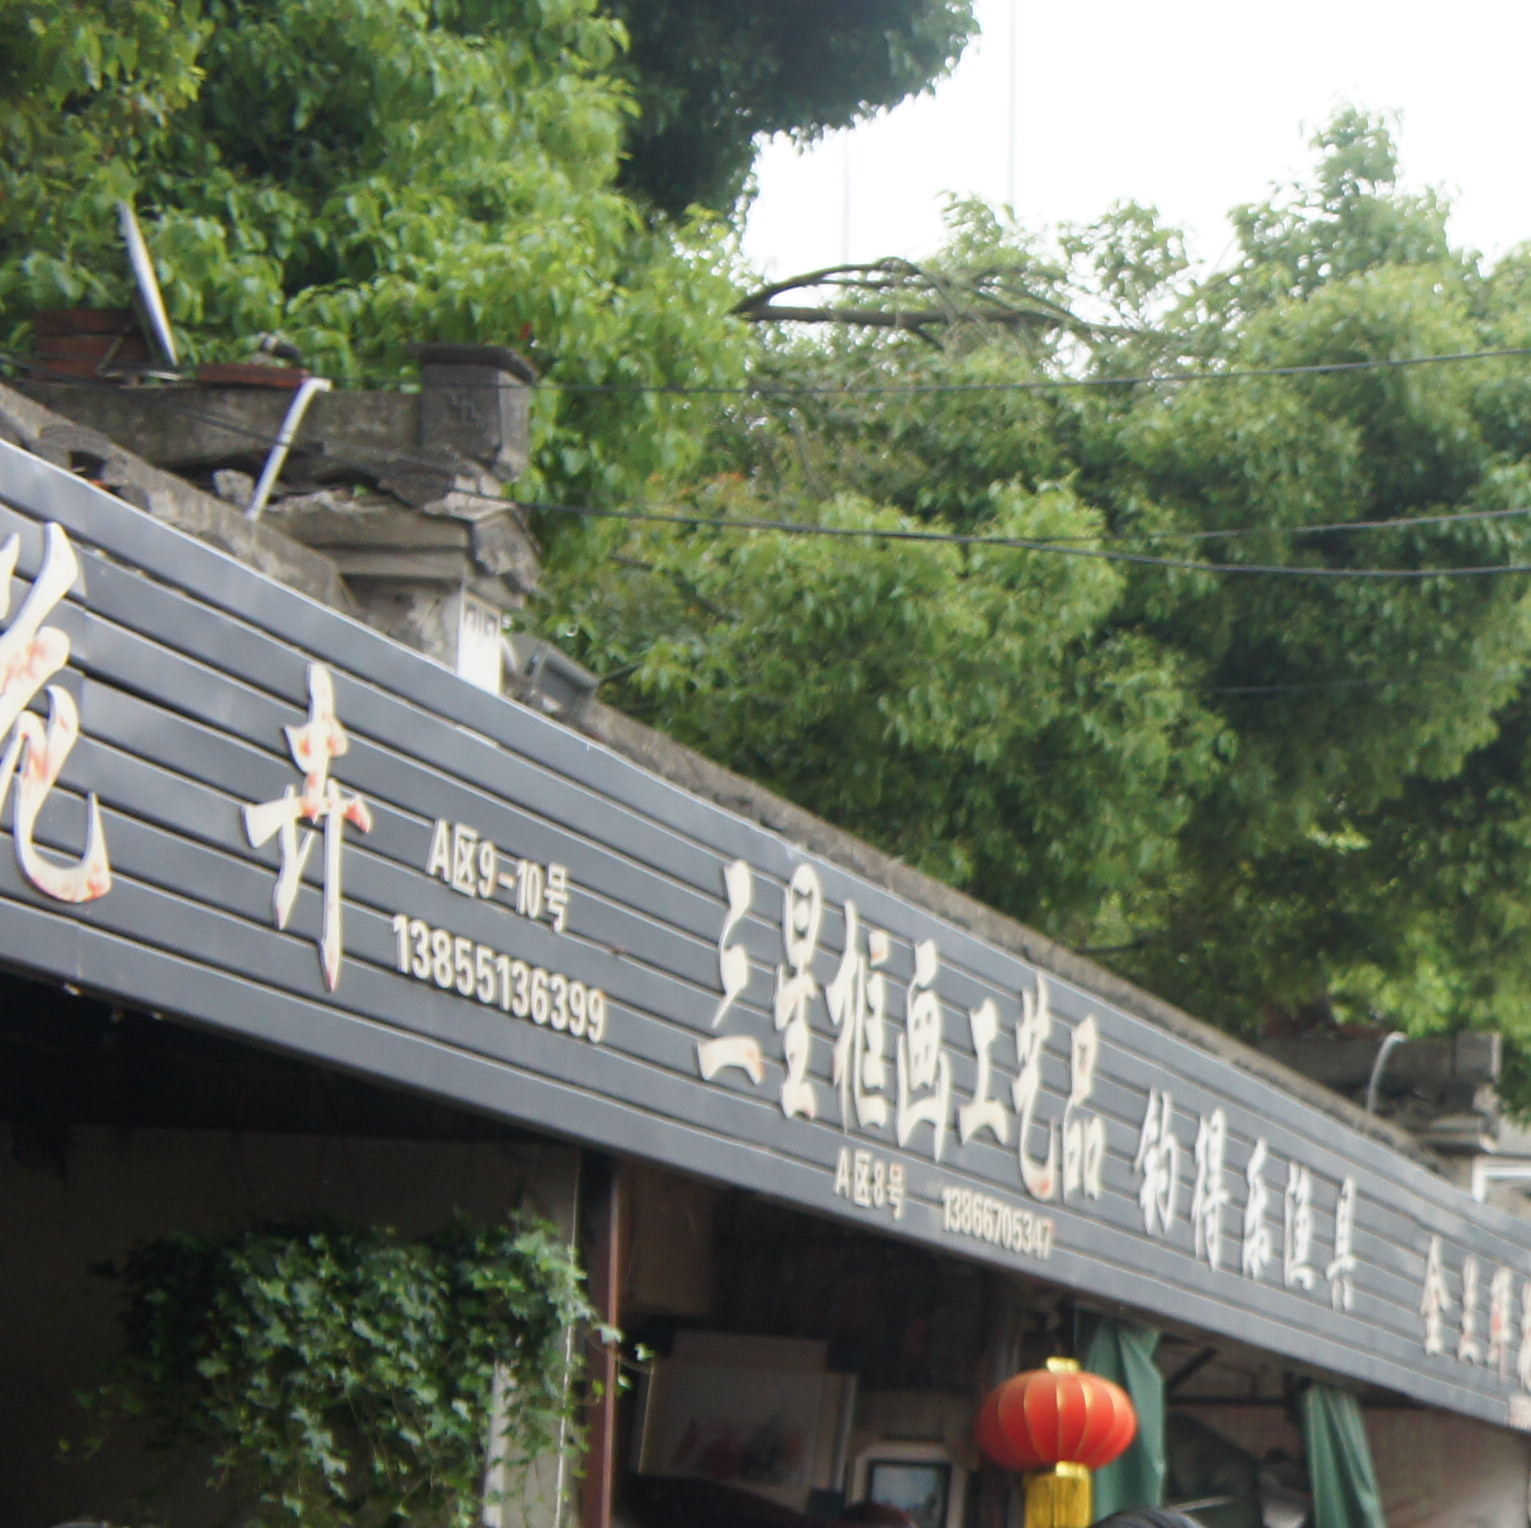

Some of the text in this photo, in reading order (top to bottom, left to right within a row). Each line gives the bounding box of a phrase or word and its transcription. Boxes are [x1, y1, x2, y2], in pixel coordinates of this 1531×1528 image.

[426, 817, 569, 933] A区9-10号
[393, 912, 608, 1044] 13855136399
[834, 1146, 906, 1222] A区8号
